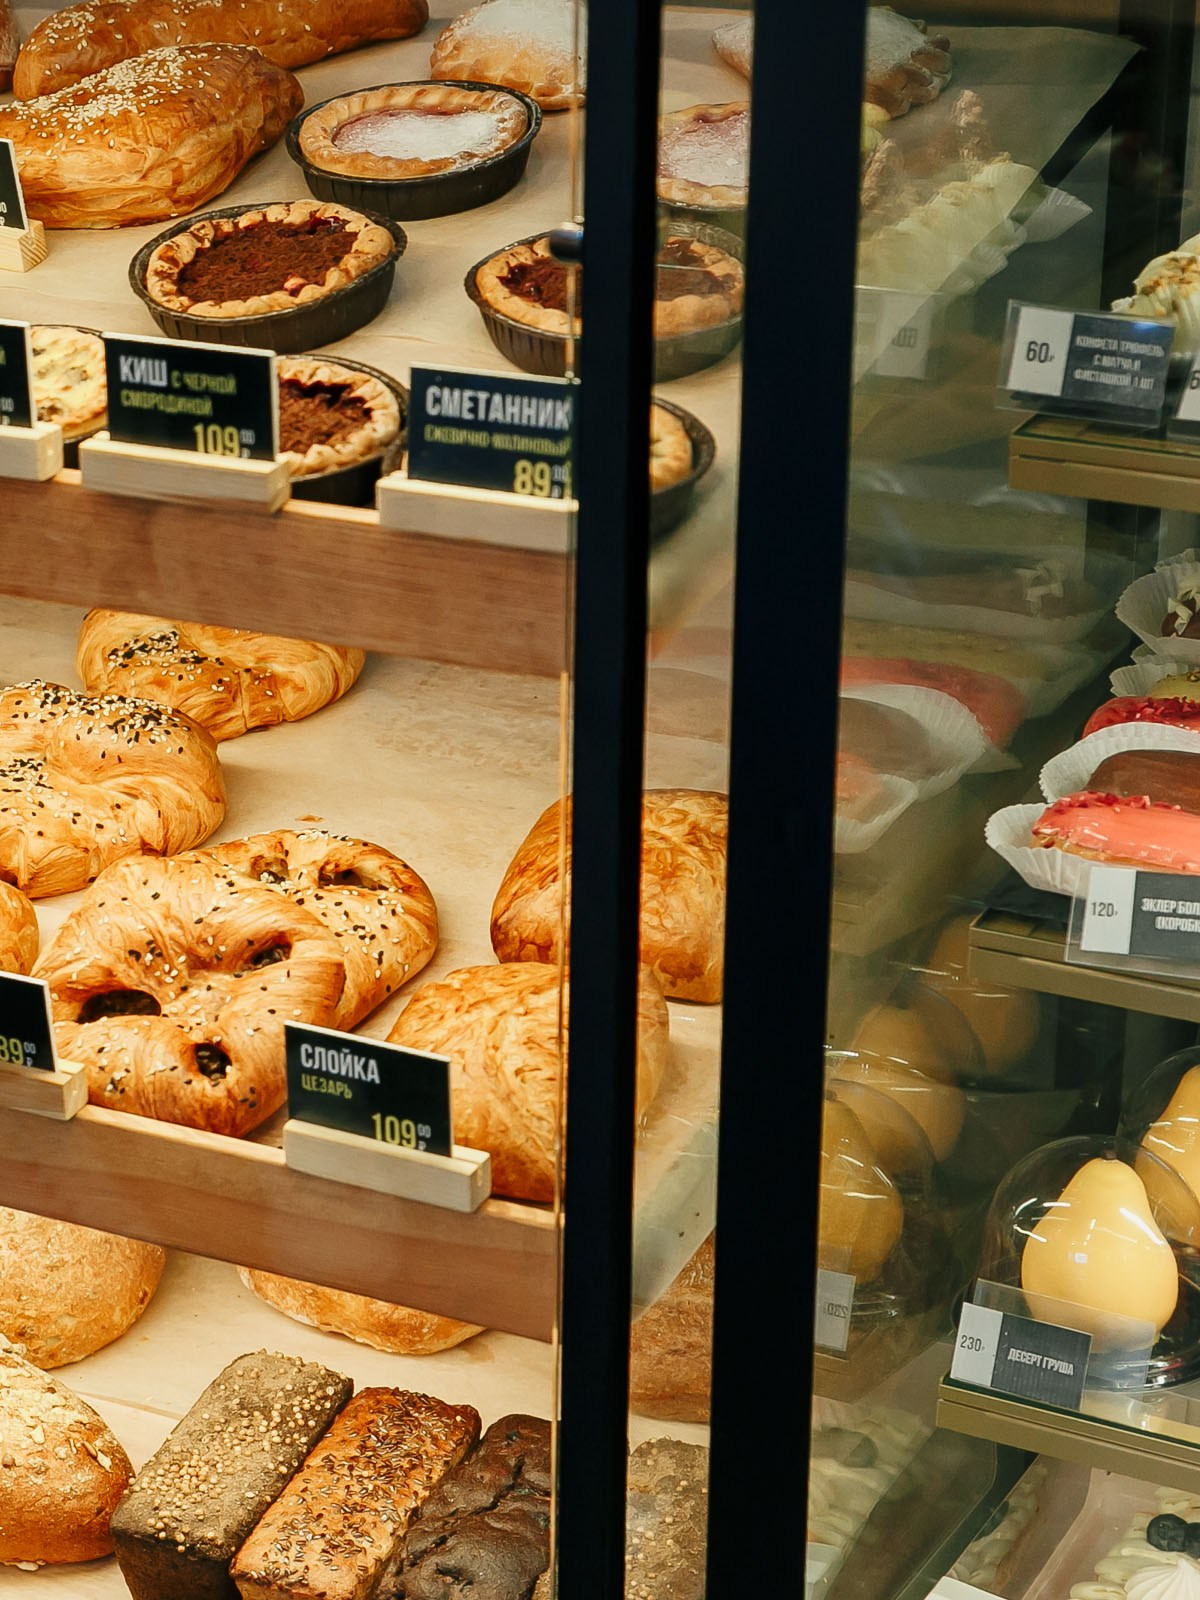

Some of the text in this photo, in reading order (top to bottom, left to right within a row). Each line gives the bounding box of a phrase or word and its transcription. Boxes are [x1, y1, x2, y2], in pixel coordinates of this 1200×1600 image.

[119, 355, 168, 388] КИШ
[171, 370, 182, 388] С
[425, 384, 571, 431] СМЕТАННИК
[193, 422, 241, 458] 109
[513, 459, 551, 498] 89
[1140, 897, 1177, 914] ЭКЛЕР
[300, 1043, 381, 1084] СЛОЙКА
[301, 1073, 353, 1100] ЦЕЗАРЬ
[371, 1112, 418, 1150] 109
[1007, 1347, 1074, 1377] ДЕСЕРТ ГРУША
